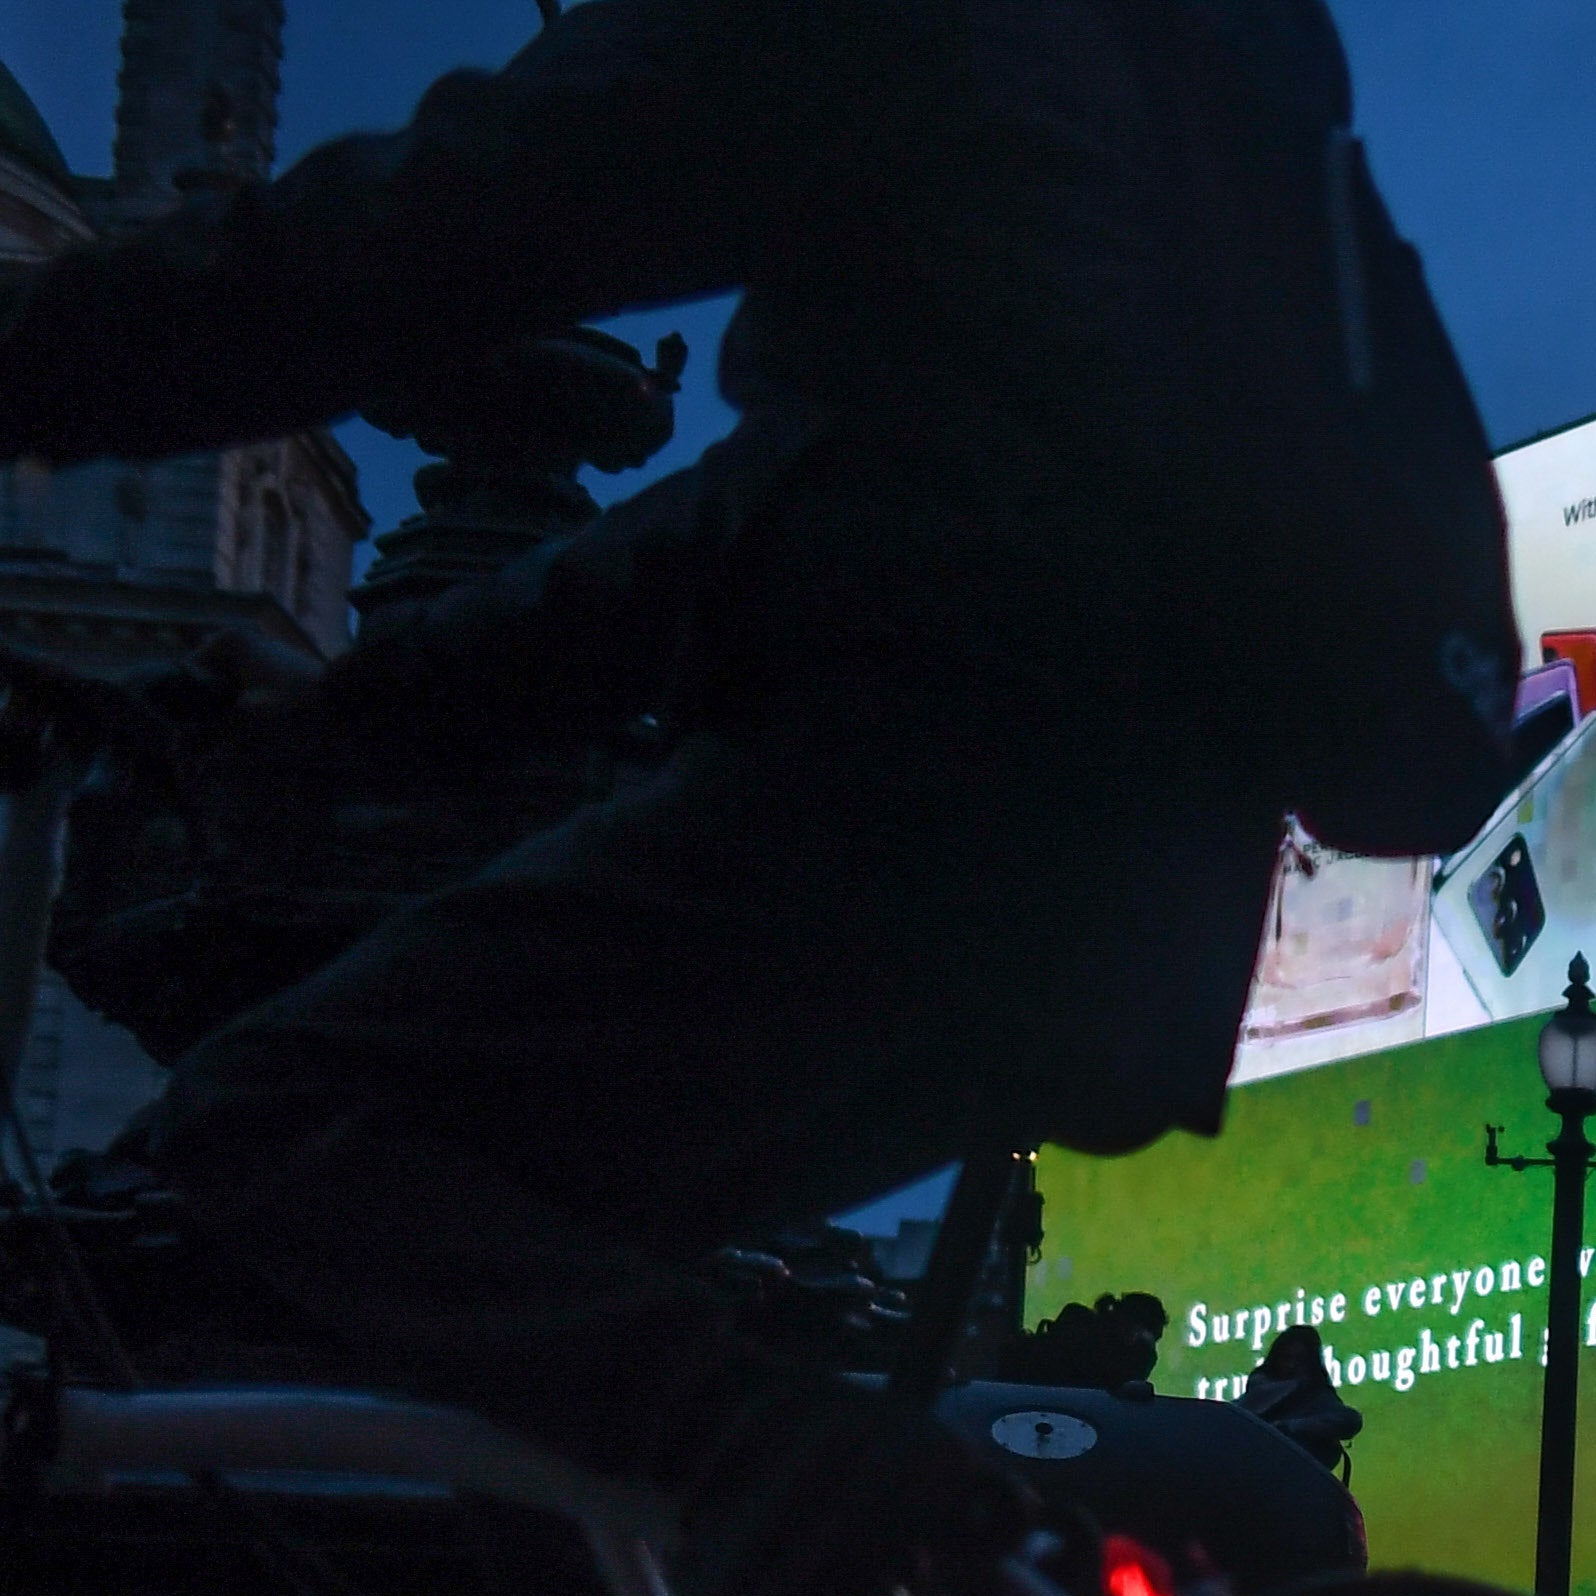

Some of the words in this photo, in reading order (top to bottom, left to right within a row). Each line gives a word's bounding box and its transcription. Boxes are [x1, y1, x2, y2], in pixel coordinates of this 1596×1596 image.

[1187, 1286, 1347, 1351] Surprise
[1364, 1255, 1546, 1316] everyone
[1321, 1312, 1523, 1393] houghtful
